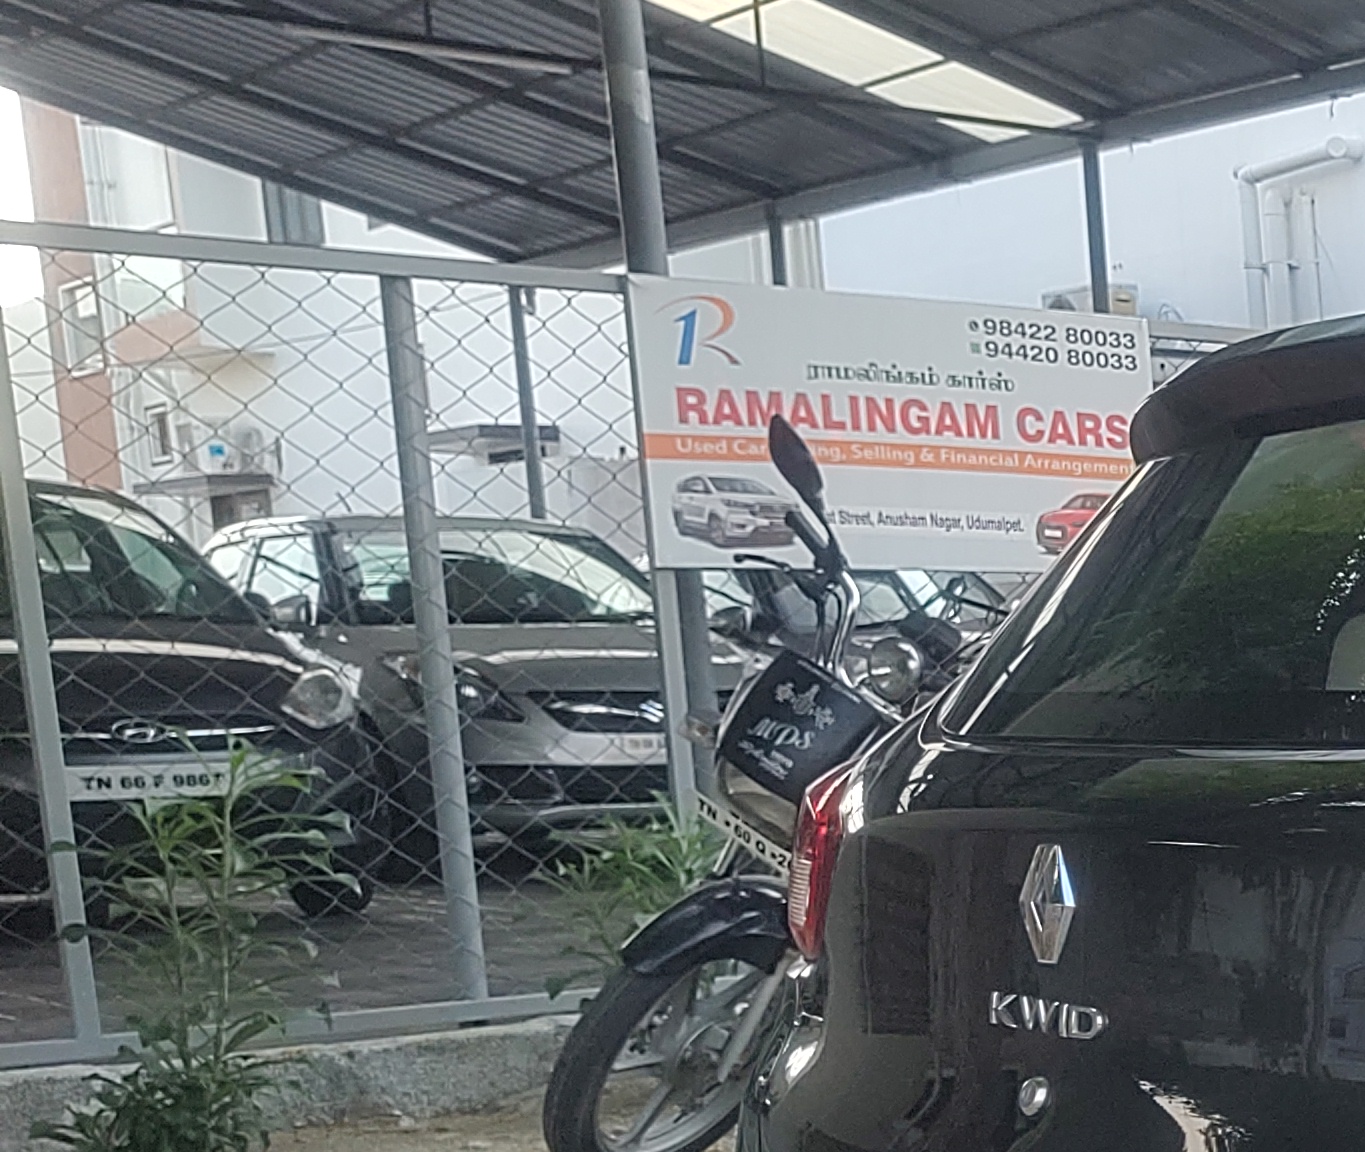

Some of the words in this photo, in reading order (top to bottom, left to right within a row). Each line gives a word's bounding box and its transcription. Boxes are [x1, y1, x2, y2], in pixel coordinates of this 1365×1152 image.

[983, 318, 1058, 343] 98422
[1065, 322, 1137, 351] 80033
[984, 340, 1059, 365] 94420
[1066, 345, 1139, 372] 80033
[807, 362, 940, 387] ராமலிங்கம்
[945, 370, 1016, 393] கார்ஸ்
[675, 387, 1000, 441] RAMALINGAM
[1016, 406, 1129, 451] CARS
[675, 437, 728, 455] Used
[853, 443, 915, 466] Selling
[919, 447, 936, 463] &
[940, 448, 1019, 468] Financial
[81, 776, 112, 790] TN
[698, 798, 717, 820] TN
[989, 990, 1105, 1040] KWID
